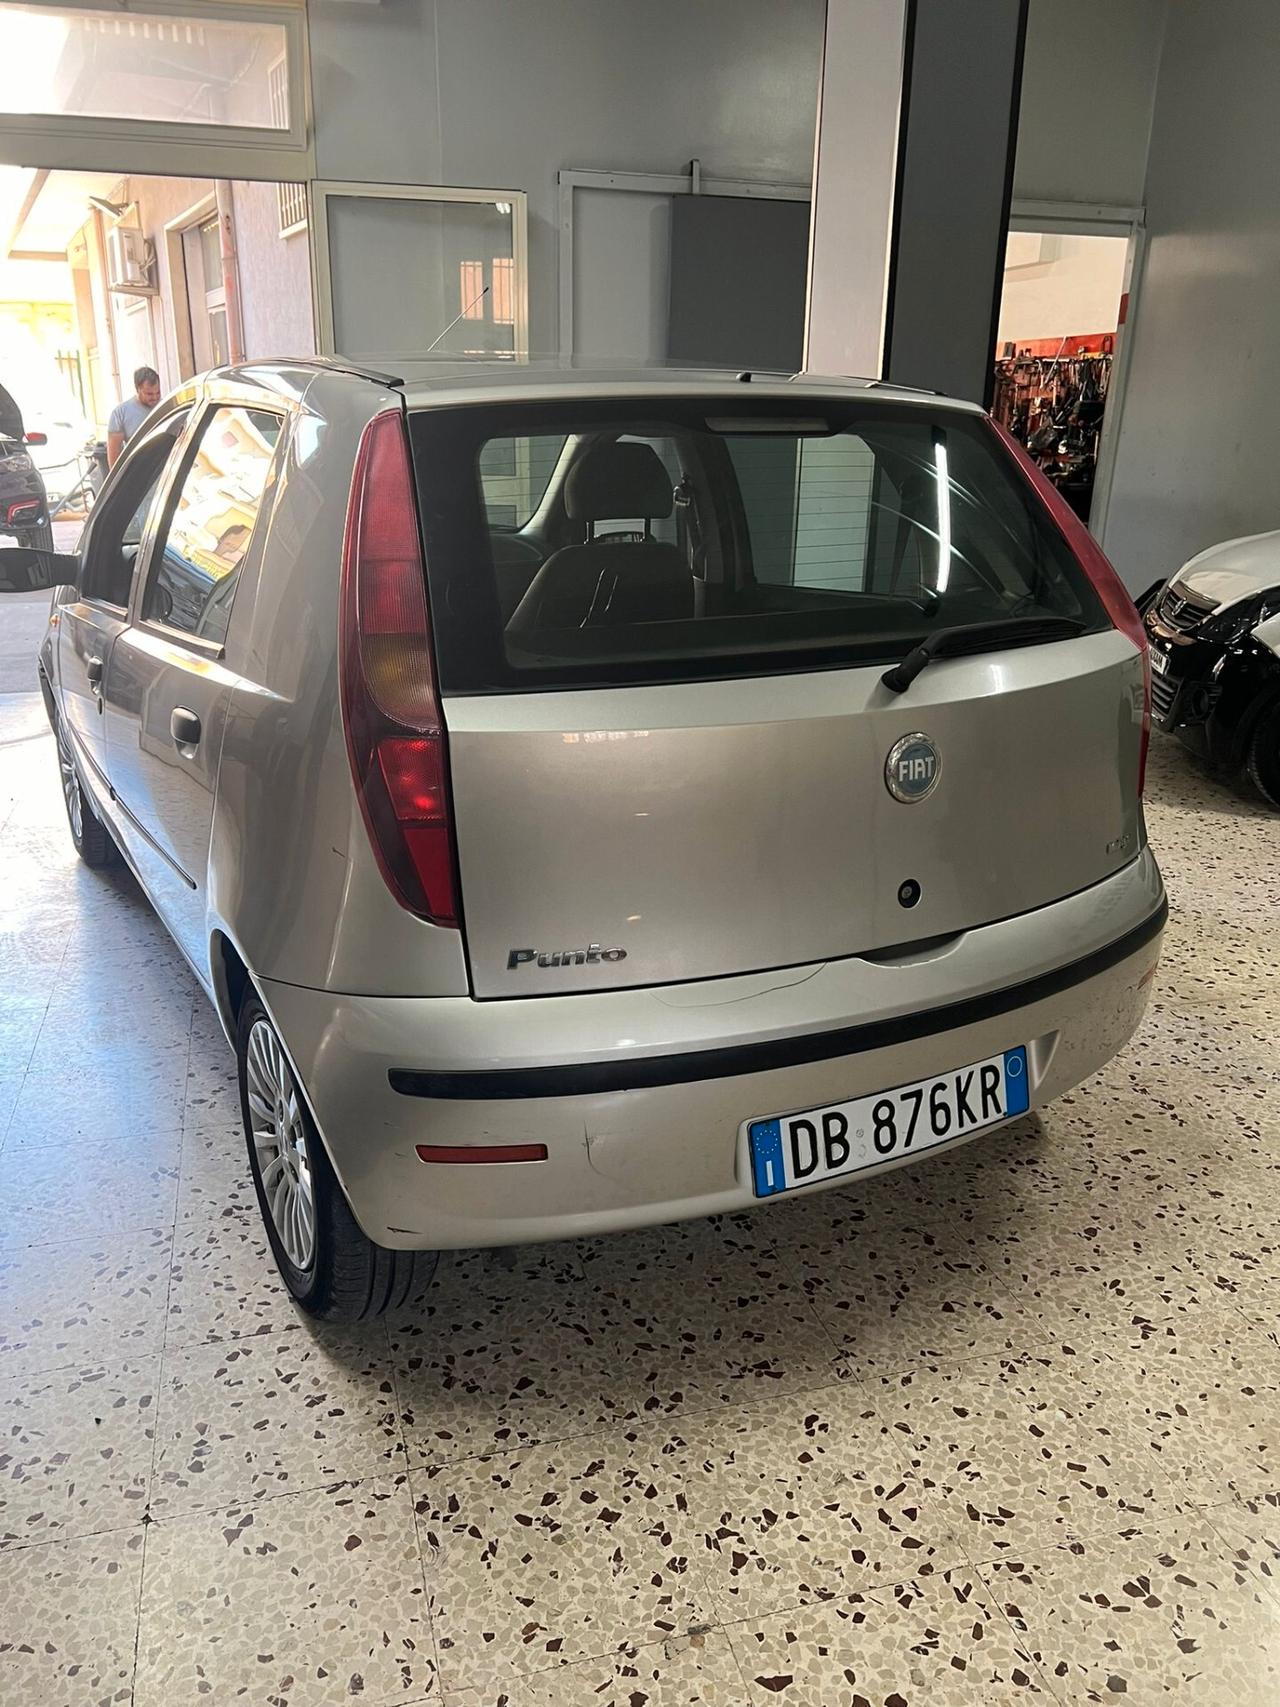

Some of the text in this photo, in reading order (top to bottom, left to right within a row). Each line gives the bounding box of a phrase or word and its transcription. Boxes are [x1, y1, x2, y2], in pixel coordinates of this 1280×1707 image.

[899, 756, 934, 782] FIAT
[507, 943, 627, 970] Punto
[789, 1111, 850, 1179] DB
[872, 1064, 1003, 1154] 876KR
